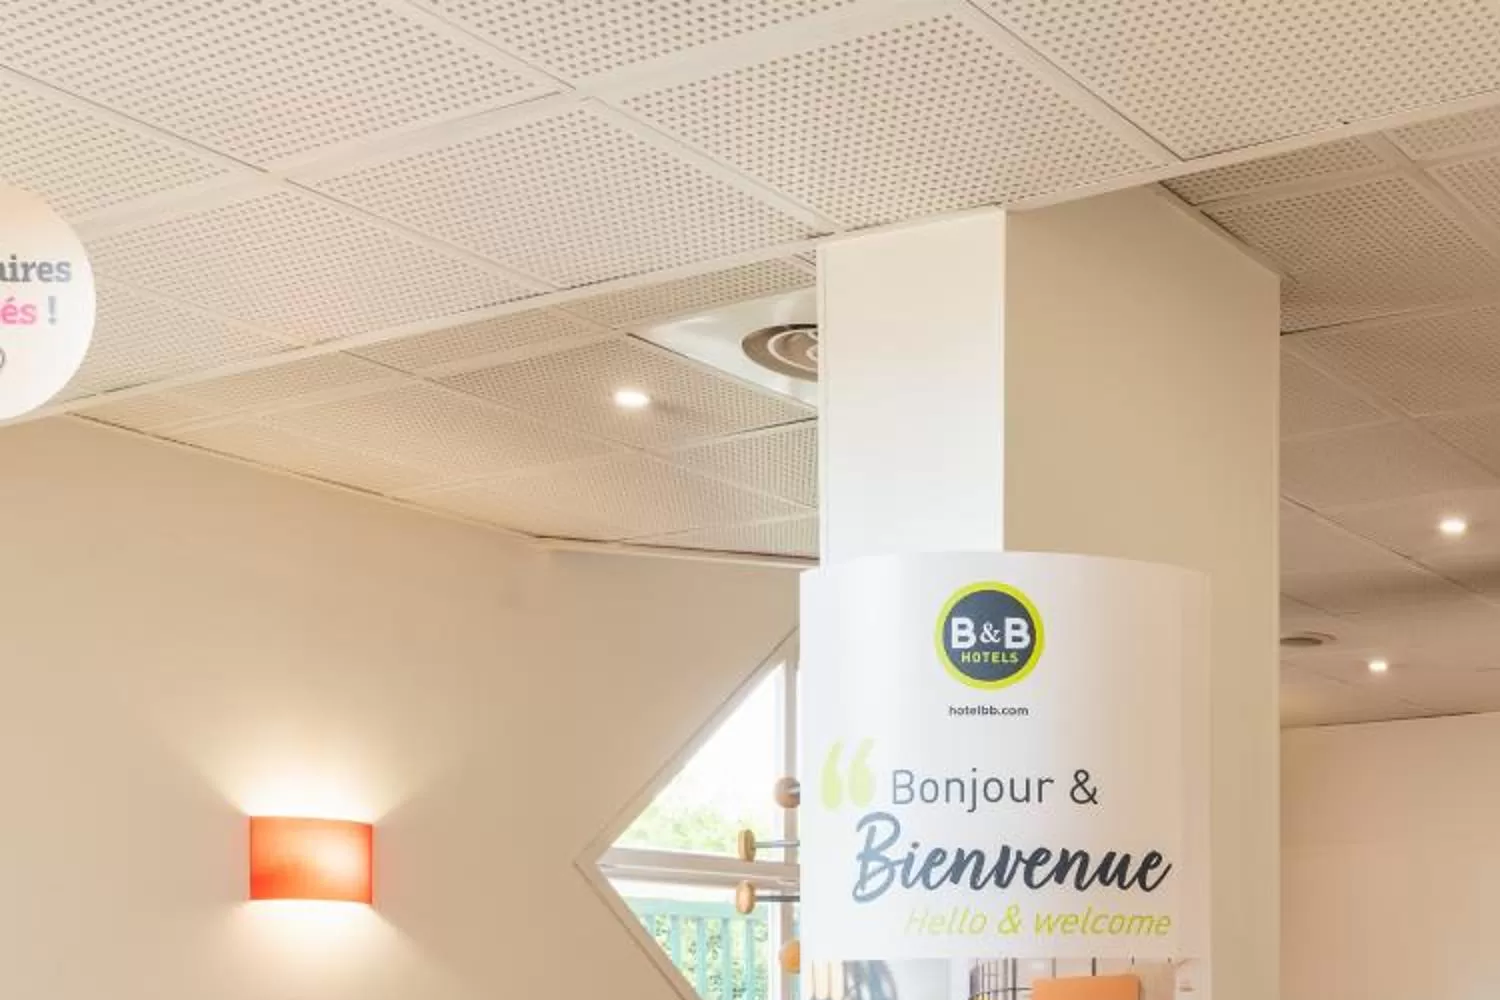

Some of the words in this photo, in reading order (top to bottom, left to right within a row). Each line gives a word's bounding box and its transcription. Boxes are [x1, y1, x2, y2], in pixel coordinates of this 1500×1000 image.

[0, 254, 71, 282] ires
[951, 616, 1031, 649] B&B
[961, 652, 1019, 663] HOTELS
[949, 704, 1029, 716] hotelbb.com
[892, 768, 1055, 813] Bonjour
[1069, 768, 1099, 806] &
[852, 811, 1172, 904] Bienvenue
[904, 904, 988, 935] Hello
[997, 903, 1021, 936] &
[1034, 905, 1172, 936] welcome
